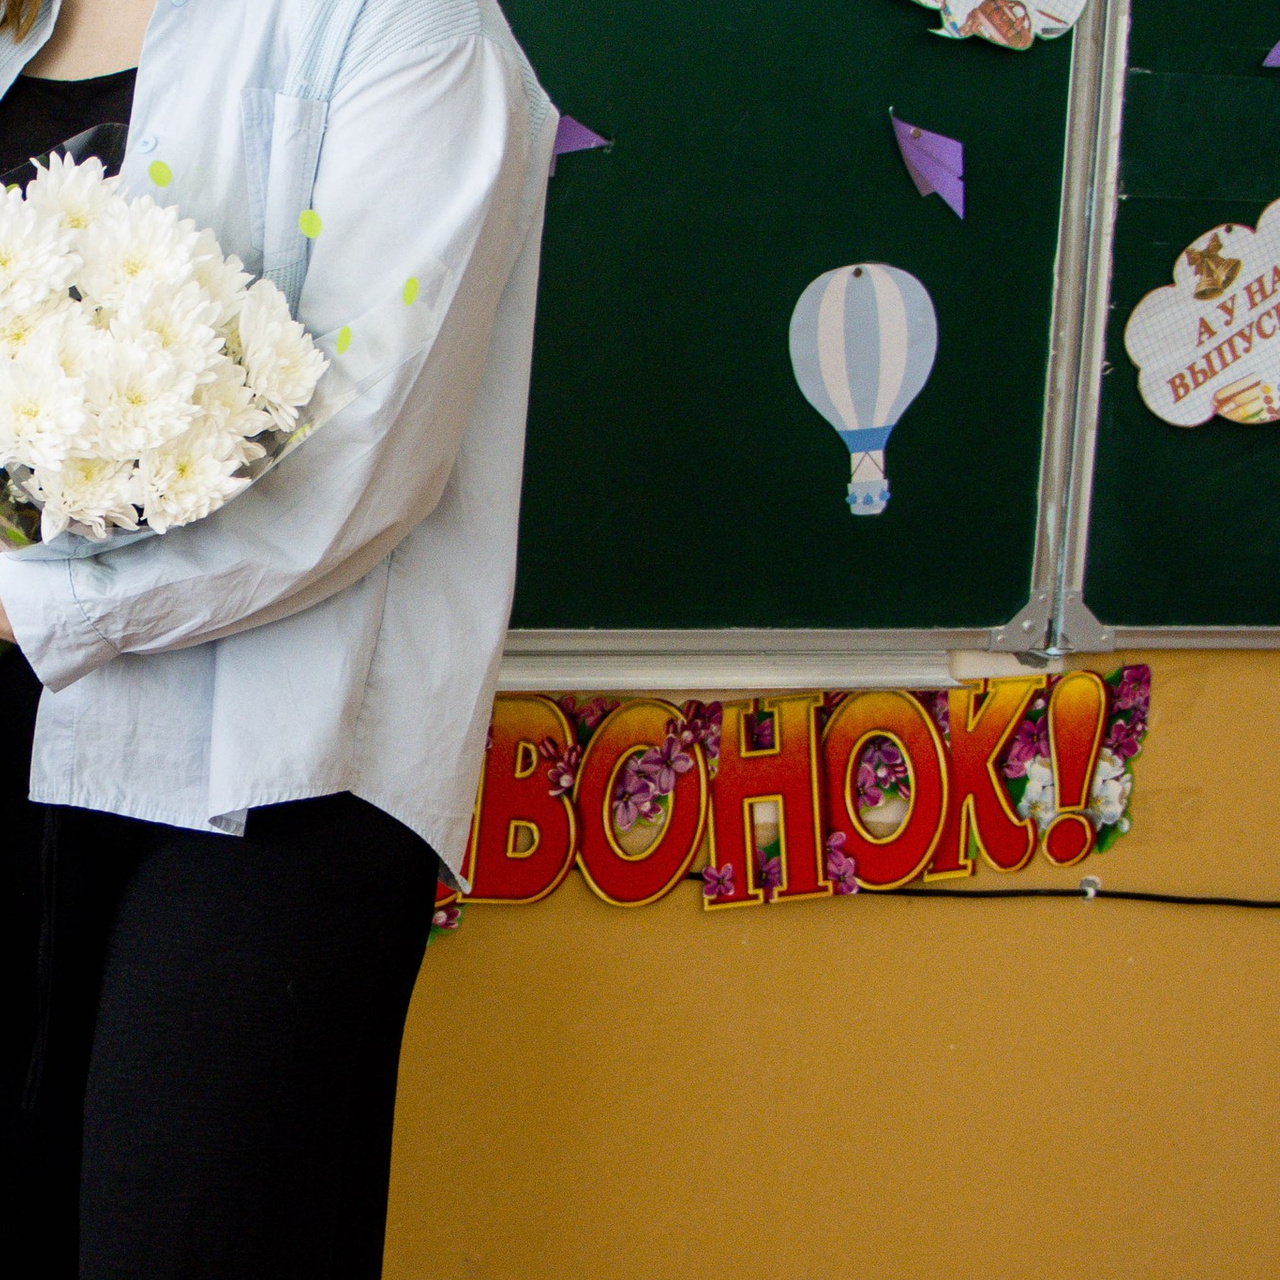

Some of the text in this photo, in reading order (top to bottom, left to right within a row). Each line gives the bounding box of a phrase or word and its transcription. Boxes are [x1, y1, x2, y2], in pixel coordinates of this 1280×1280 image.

[1166, 302, 1280, 405] ВЫПУС
[1195, 317, 1217, 347] А
[1216, 293, 1237, 327] У
[434, 669, 1108, 910] ВОНОК!
